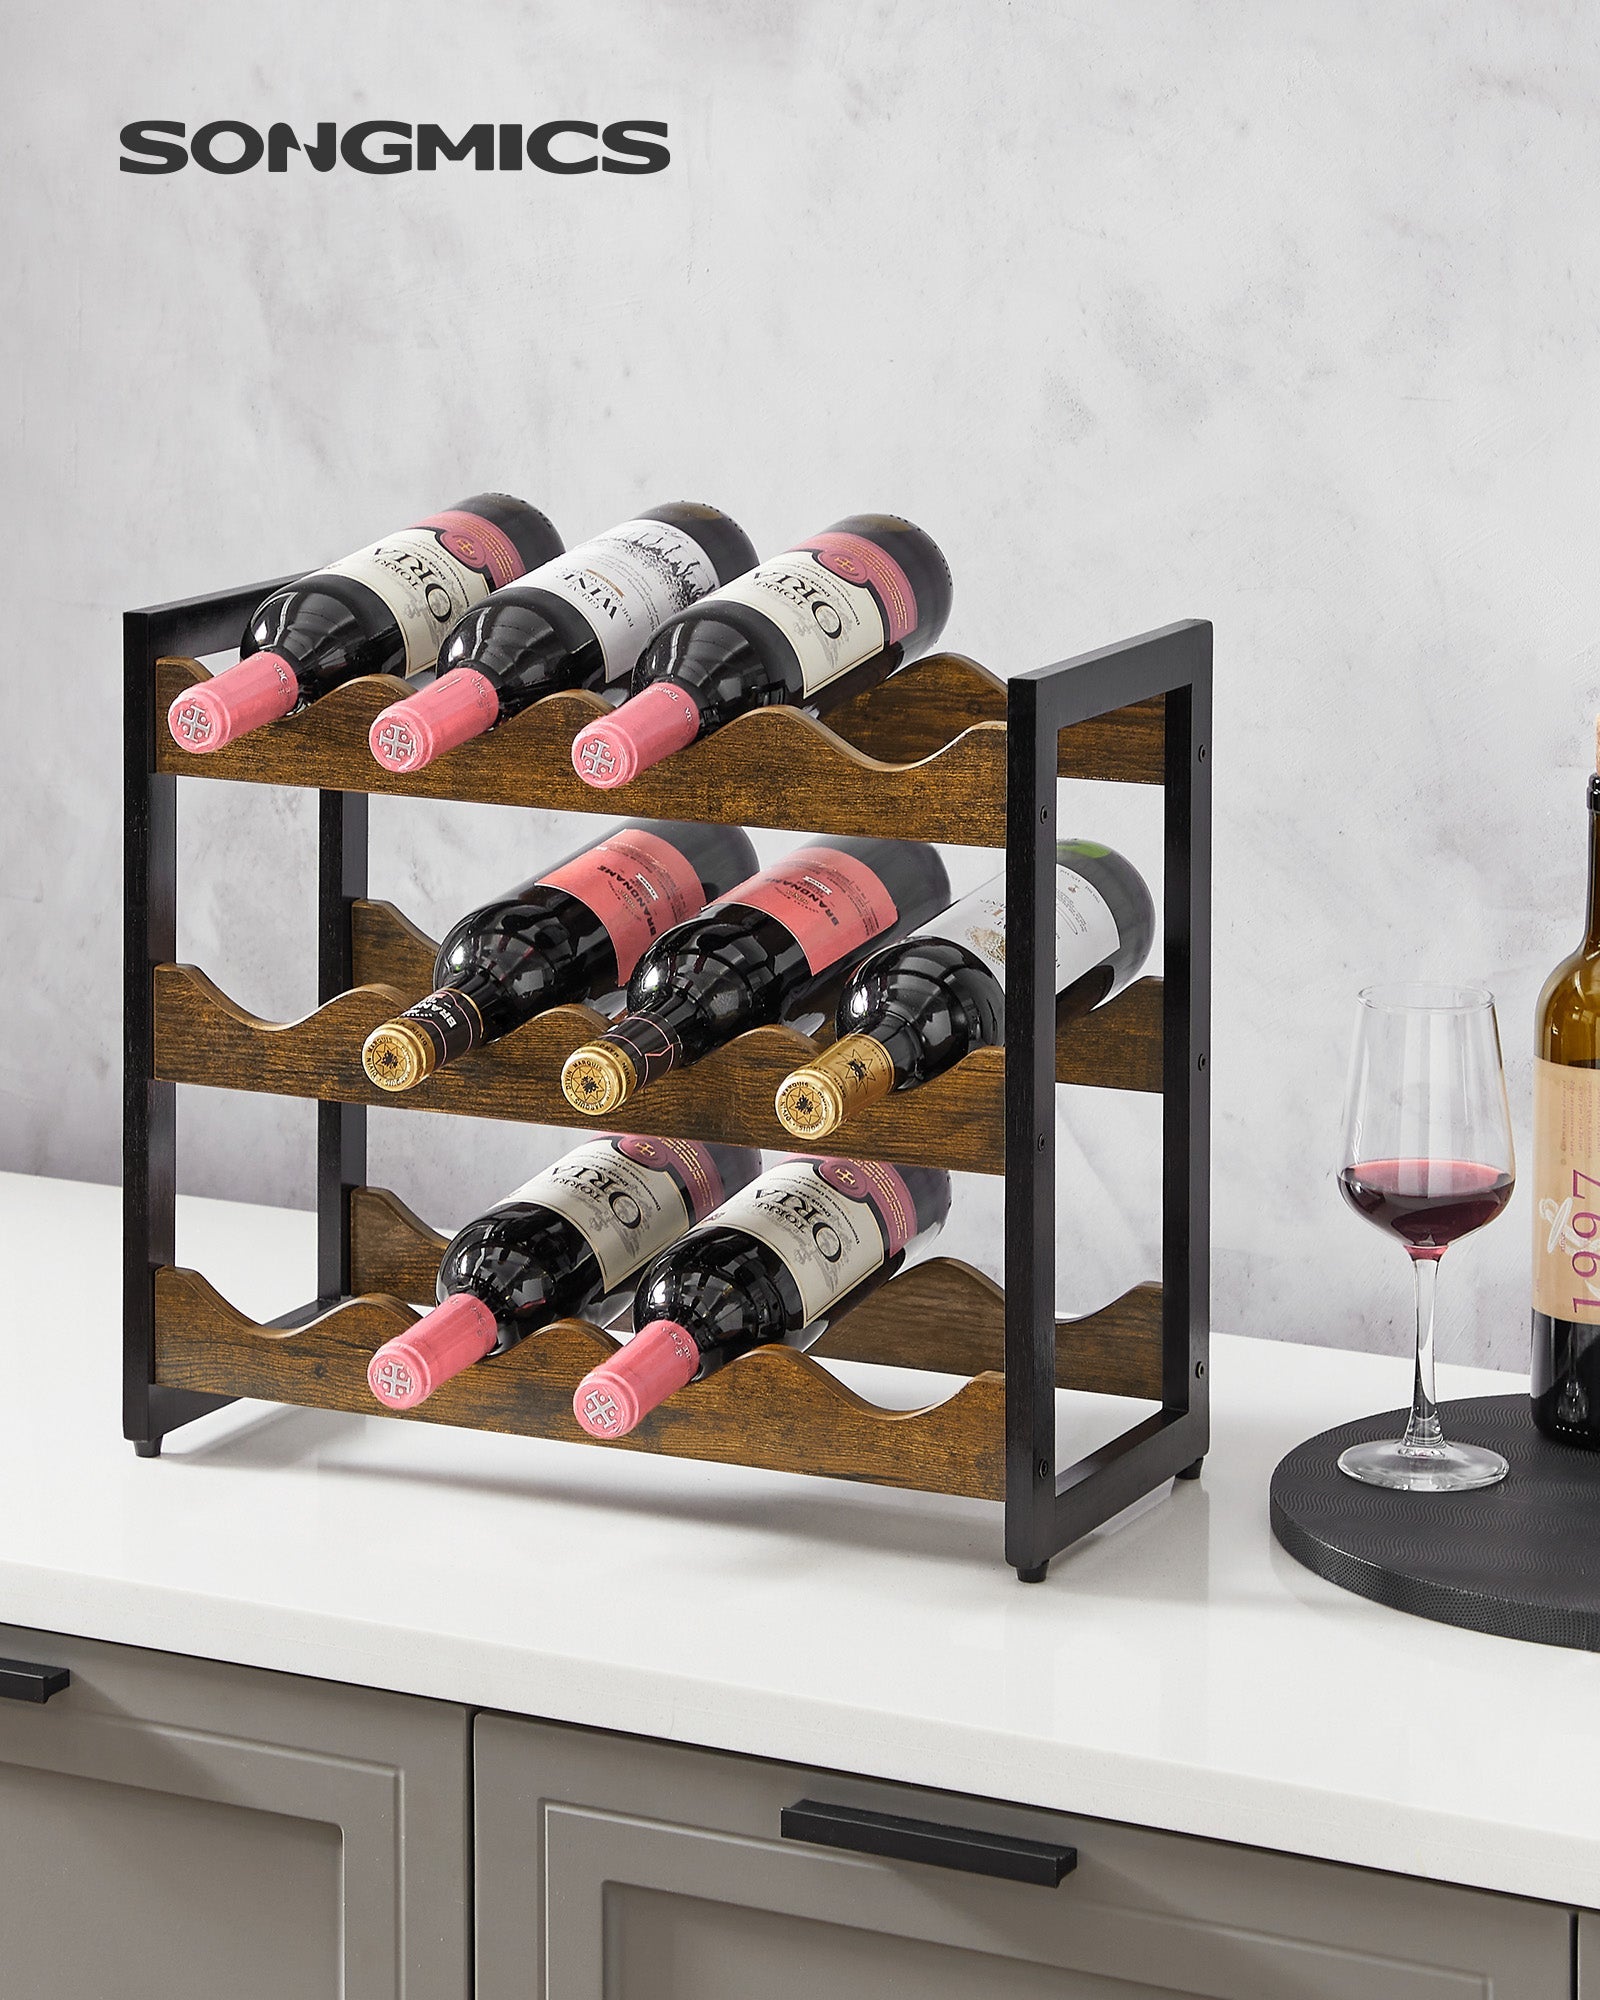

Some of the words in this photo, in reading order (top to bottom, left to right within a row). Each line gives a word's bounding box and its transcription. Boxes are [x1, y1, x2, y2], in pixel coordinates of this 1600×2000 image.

[596, 864, 657, 936] BRANDNAME
[565, 1070, 573, 1088] DIVIN
[573, 1098, 603, 1110] MARQUIS
[755, 1190, 841, 1260] ORIA
[1571, 1169, 1600, 1313] 1997
